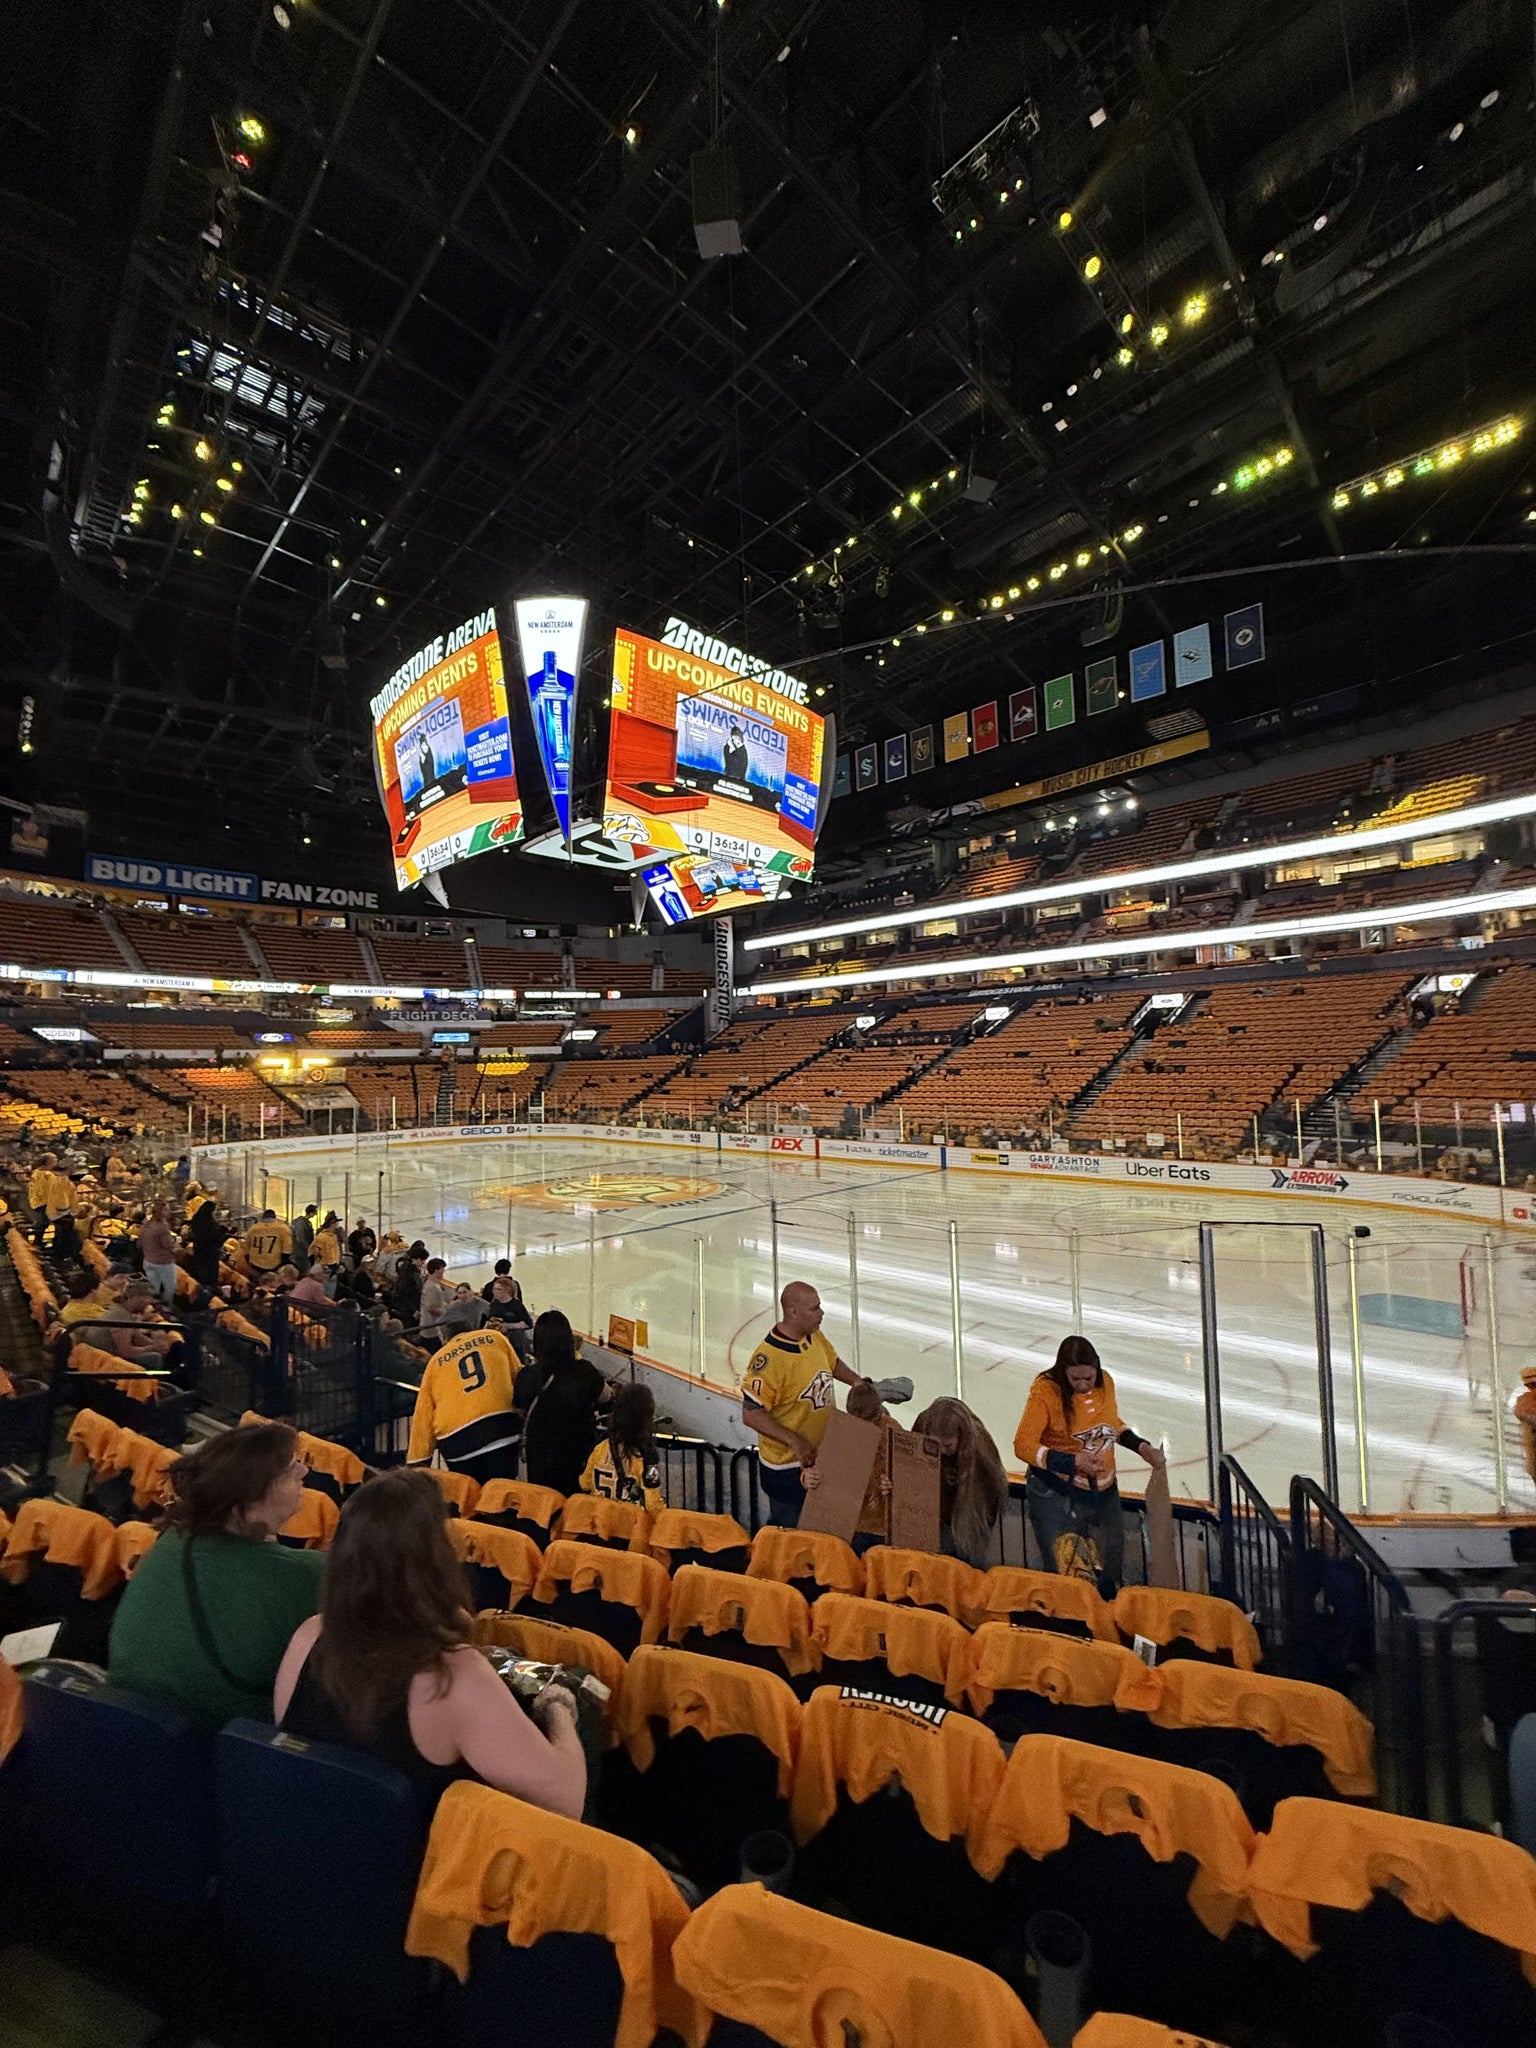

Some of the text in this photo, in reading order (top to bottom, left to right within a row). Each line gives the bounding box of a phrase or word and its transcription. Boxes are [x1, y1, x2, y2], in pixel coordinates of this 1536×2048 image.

[540, 621, 573, 629] AMSTERDAM
[369, 635, 443, 727] BRIDGESTONE
[445, 607, 497, 657] ARENA
[660, 616, 808, 706] BRIDGESTONE
[382, 685, 427, 740] UPCOMING
[427, 651, 478, 700] EVENTS
[647, 648, 754, 707] UPCOMING
[756, 694, 809, 732] EVENTS
[425, 702, 459, 734] TEDDY
[681, 699, 738, 729] SWIMS
[742, 720, 786, 752] TEDDY
[1041, 751, 1150, 795] MUSIC CITY HOCKEY
[430, 842, 449, 858] 36:34
[455, 837, 461, 848] 0
[695, 833, 703, 844] 0
[714, 837, 745, 853] 36:34
[754, 847, 761, 858] 0
[91, 859, 379, 910] BUD LIGHT FAN ZONE
[715, 920, 730, 1026] BRIDGESTONE
[390, 1011, 477, 1021] FLIGHT DECK
[460, 1127, 502, 1136] GEICO
[770, 1137, 804, 1151] DEX
[879, 1148, 929, 1159] ticketmaster
[1029, 1154, 1100, 1167] GARY ASHTON
[1125, 1162, 1211, 1181] Uber Eats
[1290, 1170, 1337, 1185] ARROW
[253, 1235, 278, 1254] 47
[438, 1334, 494, 1366] FORSBERG
[458, 1350, 486, 1393] 9
